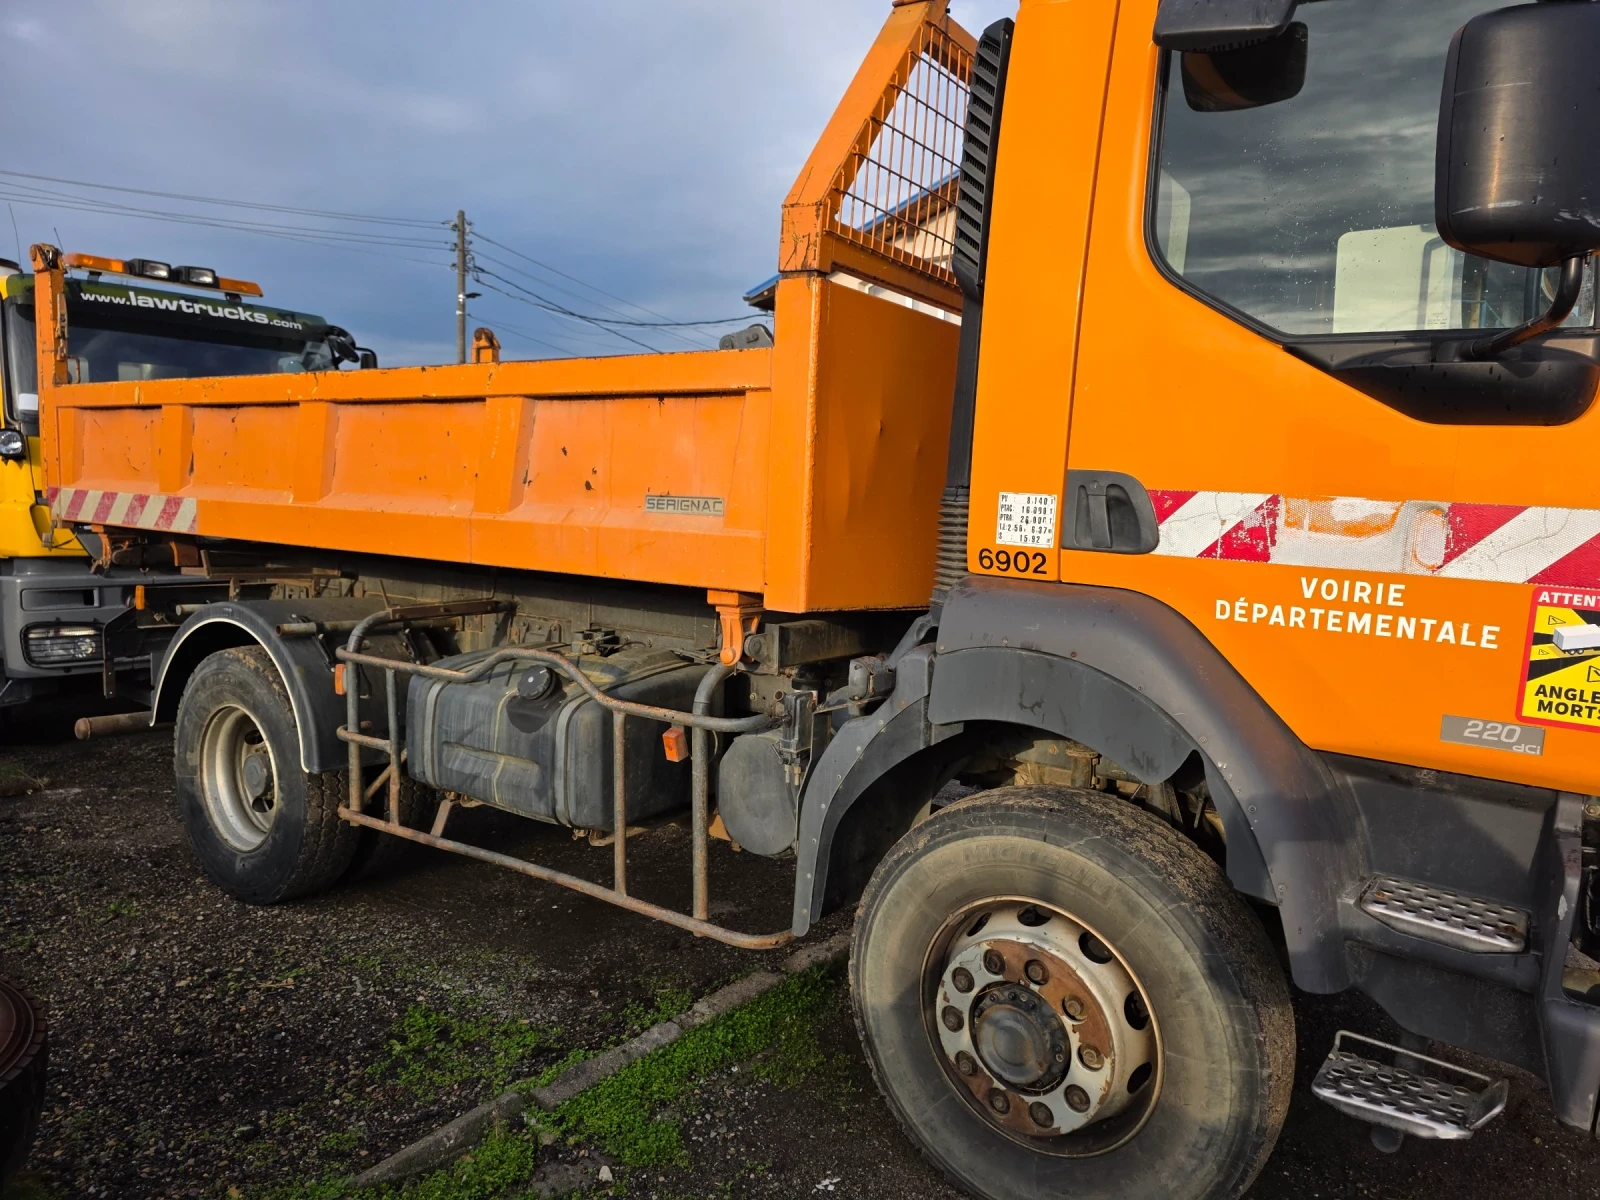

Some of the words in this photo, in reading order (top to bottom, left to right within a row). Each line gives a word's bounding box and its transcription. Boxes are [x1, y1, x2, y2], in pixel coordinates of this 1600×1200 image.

[80, 290, 303, 331] www.lawtrucks.com
[646, 498, 723, 513] SERIGNAC
[978, 547, 1048, 575] 6902
[1300, 576, 1406, 608] VOIRIE
[1215, 597, 1501, 650] DÉPARTEMENTALE
[1463, 719, 1522, 743] 220
[963, 845, 1121, 907] MICHELIN
